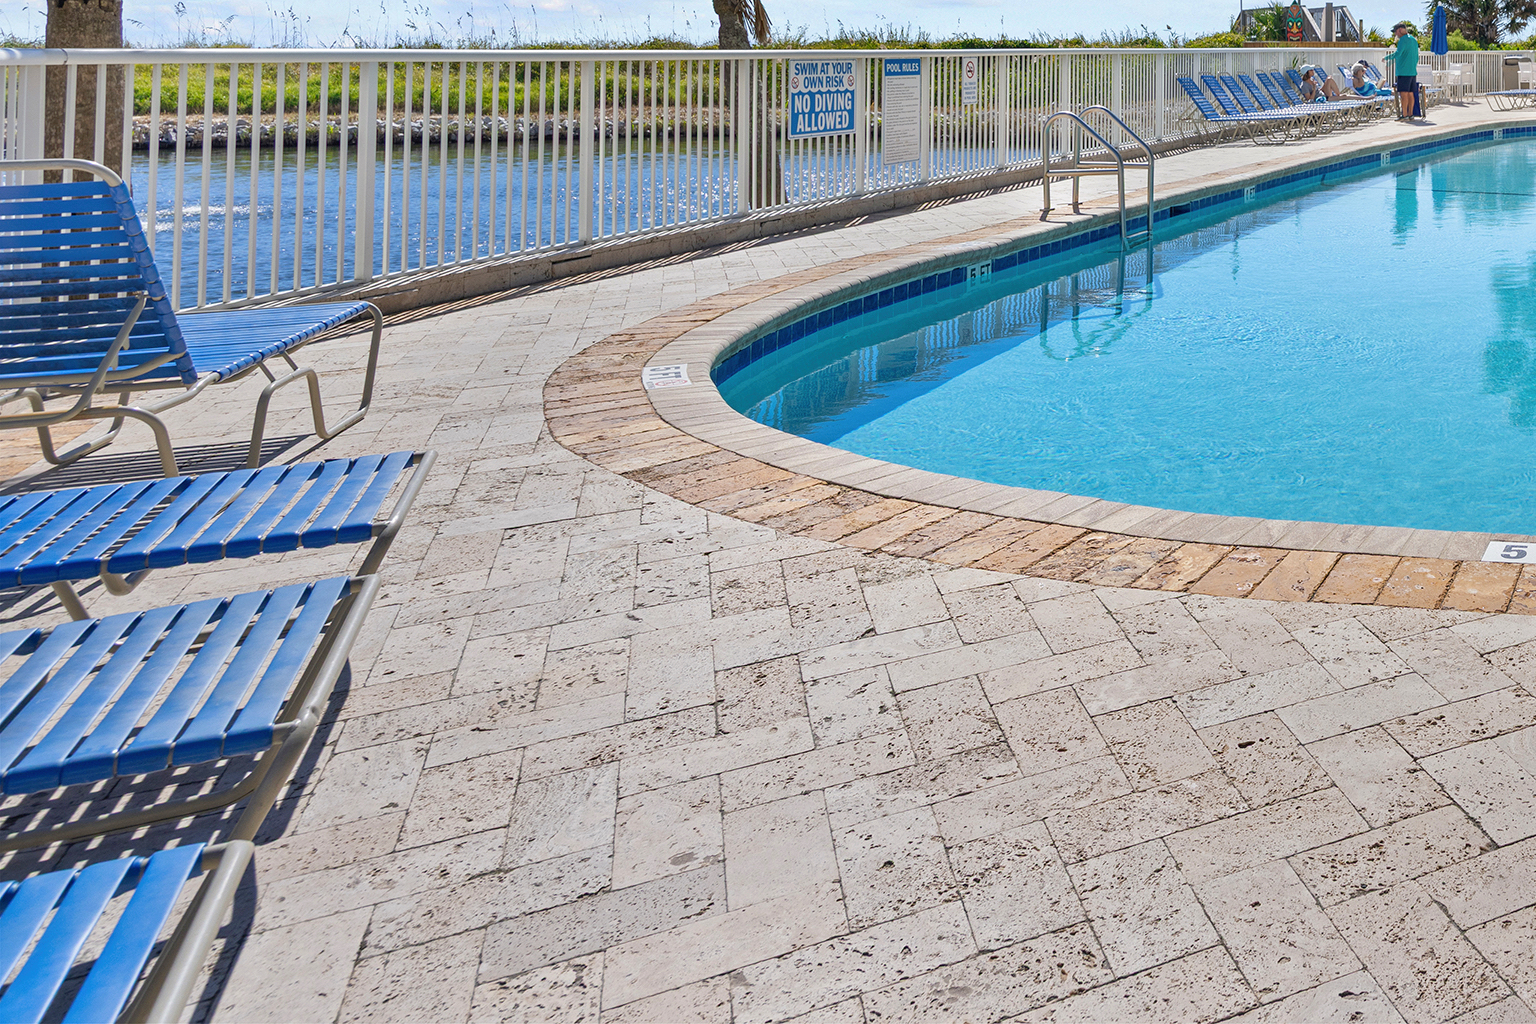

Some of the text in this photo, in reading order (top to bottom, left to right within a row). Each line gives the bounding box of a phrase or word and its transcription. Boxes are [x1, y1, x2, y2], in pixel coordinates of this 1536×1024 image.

[794, 62, 853, 76] SWIM AT YOUR
[885, 62, 919, 73] POOL RULES
[803, 75, 845, 89] OWN RISK
[794, 91, 852, 114] NO DIVING
[796, 111, 849, 133] ALLOWED
[1500, 544, 1528, 560] 5
